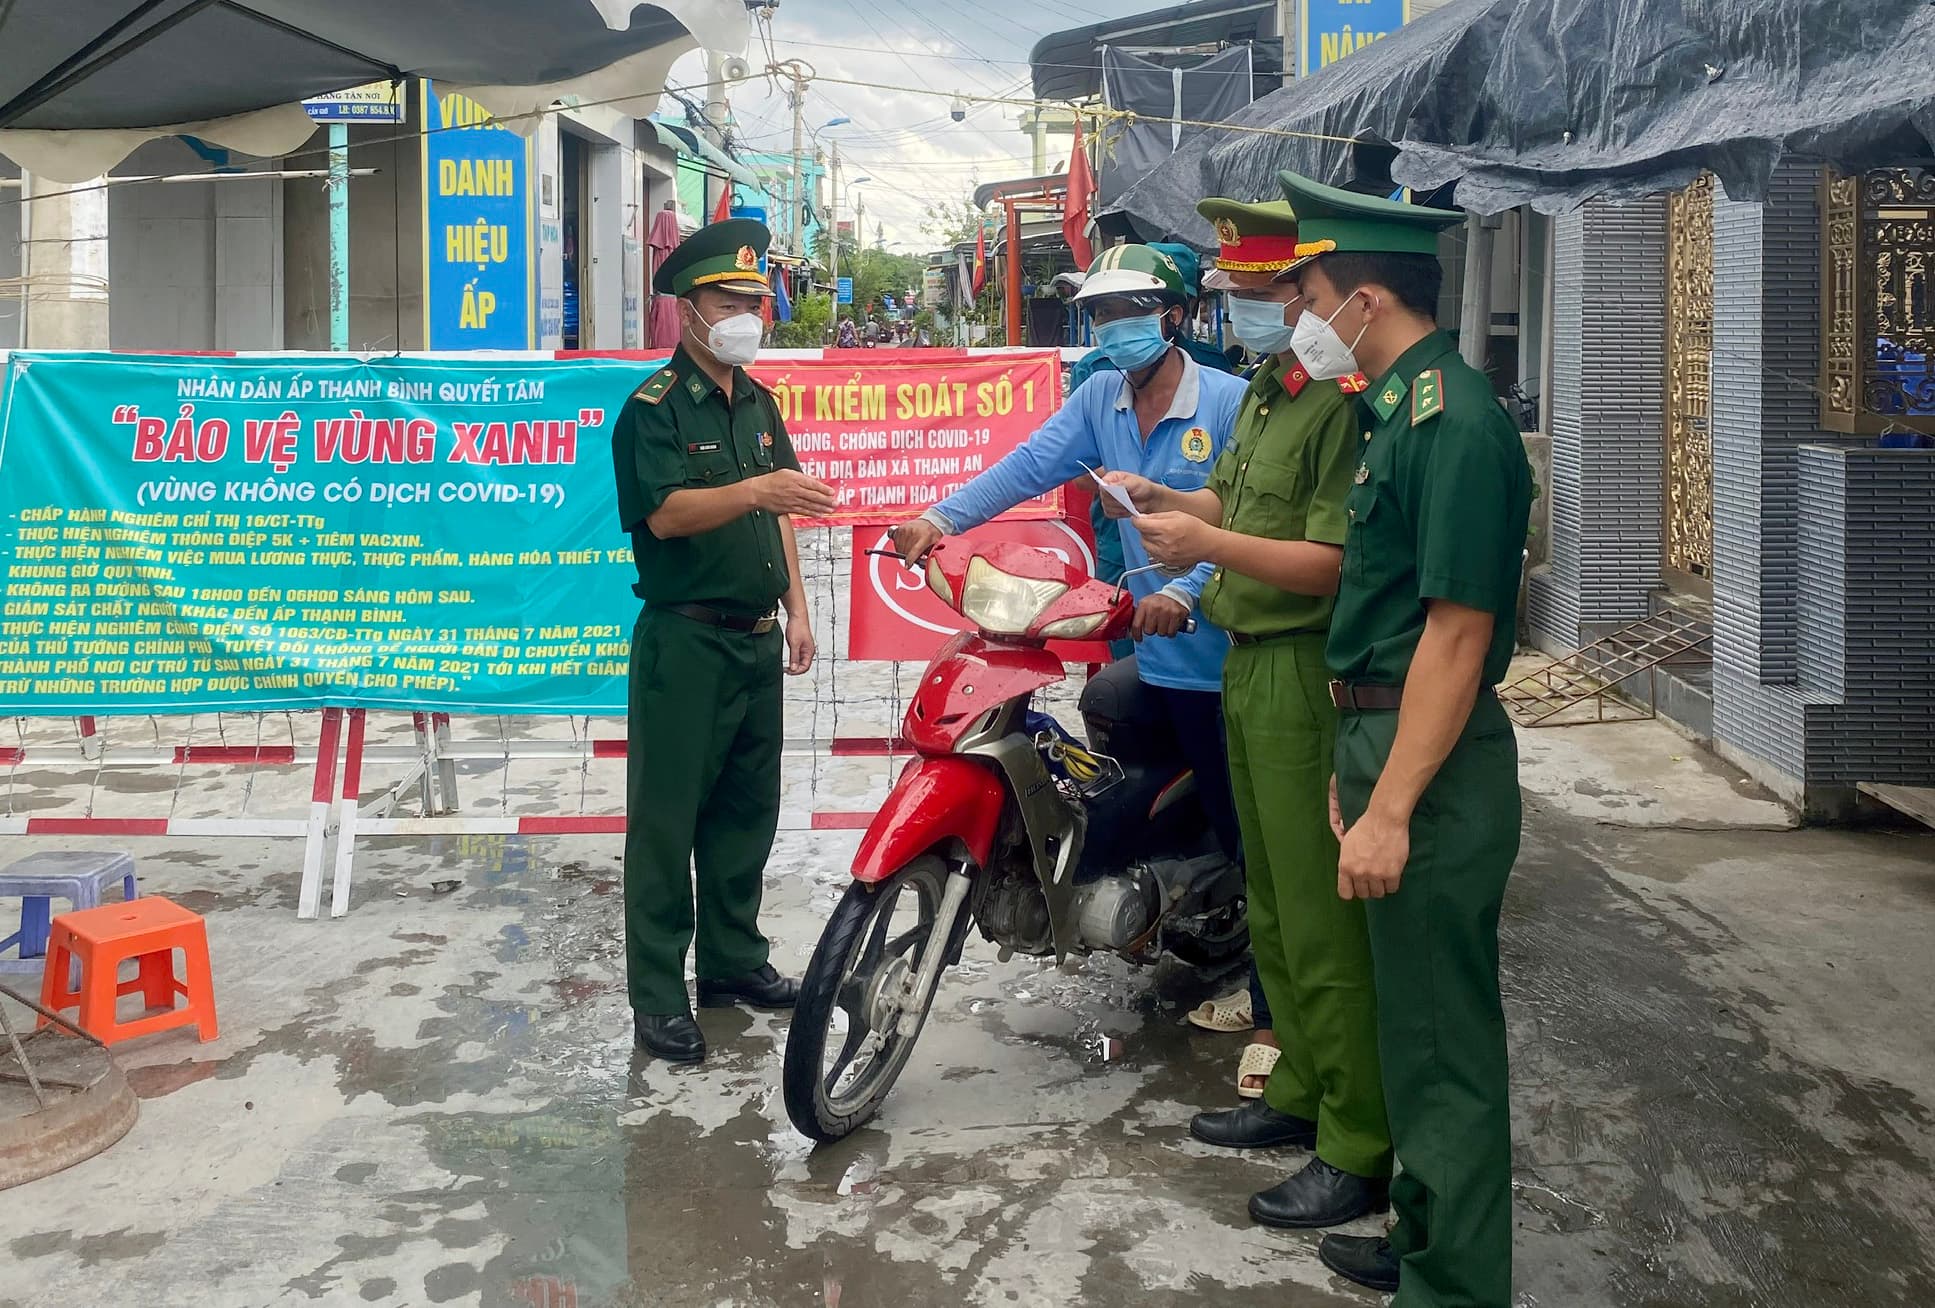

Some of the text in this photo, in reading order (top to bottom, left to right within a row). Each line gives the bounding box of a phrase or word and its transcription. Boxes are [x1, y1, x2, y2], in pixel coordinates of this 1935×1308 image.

[439, 159, 513, 197] DANH
[446, 216, 508, 272] HIỆU
[459, 278, 496, 329] ẤP
[177, 372, 544, 402] NHÂN DÂN ẤP THẠNH BÌNH QUYẾT TÂM
[773, 369, 1034, 422] ỐT KIỂM SOÁT SỐ 1
[112, 404, 604, 472] “BẢO VỆ VÙNG XANH”
[788, 426, 990, 453] HÒNG, CHỐNG DỊCH COVID-19
[800, 454, 983, 484] RÊN ĐỊA BÀN XÃ THẠNH AN
[136, 475, 565, 509] (VÙNG KHÔNG CÓ DỊCH COVID-19)
[837, 482, 856, 505] ẤP
[860, 486, 906, 508] THẠNH
[910, 480, 938, 504] HÒA
[20, 504, 325, 530] CHẤP HÀNH NGHIÊM CHỈ THỊ 16/CT-TTg
[18, 526, 58, 542] THỰC
[62, 526, 102, 542] HIỆN
[104, 528, 167, 545] NGHIÊM
[172, 530, 224, 546] THÔNG
[229, 530, 267, 548] ĐIỆP
[272, 534, 293, 546] 5K
[316, 532, 354, 546] TIÊM
[360, 534, 424, 548] VACXIN.
[15, 545, 56, 562] THỰC
[61, 544, 100, 560] HIỆN
[168, 548, 204, 566] VIỆC
[209, 551, 246, 565] MUA
[250, 551, 306, 566] LƯƠNG
[311, 551, 356, 568] THỰC,
[362, 552, 406, 568] THỰC
[468, 550, 514, 566] HÀNG
[518, 550, 552, 564] HÓA
[556, 547, 602, 564] THIẾT
[8, 565, 66, 578] KHUNG
[71, 562, 100, 578] GIỜ
[104, 566, 133, 580] QUY
[7, 582, 476, 604] KHÔNG RA ĐƯỜNG SAU 18H00 ĐẾN 06H00 SÁNG HÔM SAU.
[4, 600, 49, 616] GIÁM
[54, 600, 88, 616] SÁT
[91, 600, 134, 618] CHẶT
[181, 604, 229, 619] KHÁC
[232, 604, 268, 621] ĐẾN
[272, 604, 296, 622] ẤP
[302, 608, 356, 624] THẠNH
[361, 608, 406, 622] BÌNH.
[2, 620, 44, 638] THỰC
[48, 620, 90, 638] HIỆN
[95, 619, 162, 635] NGHIÊM
[202, 622, 244, 638] ĐIỆN
[248, 622, 274, 636] SỐ
[388, 626, 434, 641] NGÀY
[438, 628, 457, 641] 31
[464, 626, 519, 640] THÁNG
[524, 628, 535, 640] 7
[539, 624, 578, 640] NĂM
[583, 625, 621, 638] 2021
[36, 636, 68, 654] THỦ
[73, 639, 130, 654] TƯỚNG
[134, 638, 185, 654] CHÍNH
[312, 643, 372, 655] KHÔNG
[502, 646, 520, 658] DI
[525, 640, 592, 658] CHUYỂN
[54, 656, 92, 674] PHỐ
[94, 660, 126, 674] NƠI
[130, 660, 154, 674] CƯ
[158, 658, 188, 673] TRÚ
[216, 658, 240, 672] SAU
[242, 654, 286, 671] NGÀY
[290, 657, 311, 668] 31
[318, 655, 372, 668] THÁNG
[378, 656, 390, 668] 7
[394, 656, 435, 671] NĂM
[438, 660, 480, 674] 2021
[487, 662, 514, 676] TỚI
[518, 662, 547, 676] KHI
[551, 658, 582, 676] HẾT
[34, 676, 95, 694] NHỮNG
[100, 676, 166, 694] TRƯỜNG
[171, 676, 203, 694] HỢP
[207, 676, 250, 694] ĐƯỢC
[253, 672, 299, 689] CHÍNH
[303, 669, 359, 687] QUYỀN
[364, 674, 398, 688] CHO
